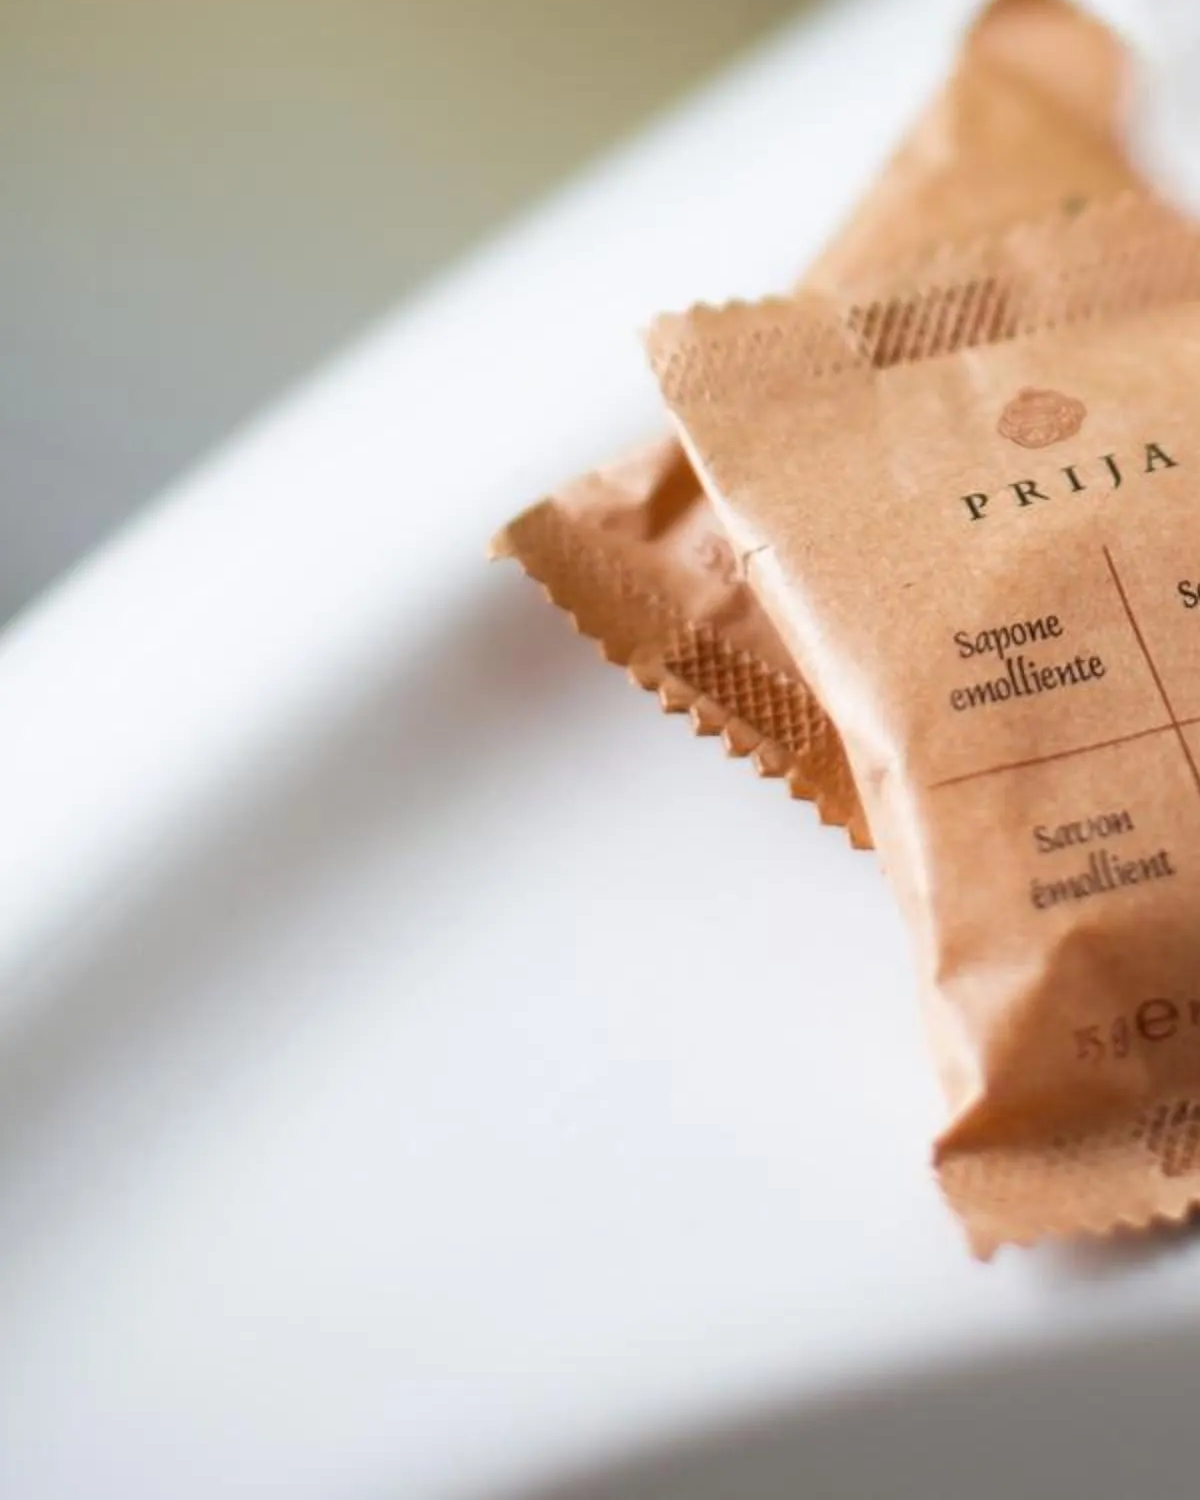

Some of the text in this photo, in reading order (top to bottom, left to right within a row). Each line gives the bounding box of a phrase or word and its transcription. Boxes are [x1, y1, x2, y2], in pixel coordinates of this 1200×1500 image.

[960, 442, 1179, 522] PRIJA
[953, 614, 1064, 660] Sapone
[950, 655, 1107, 712] emolliente
[1032, 809, 1135, 854] Savon
